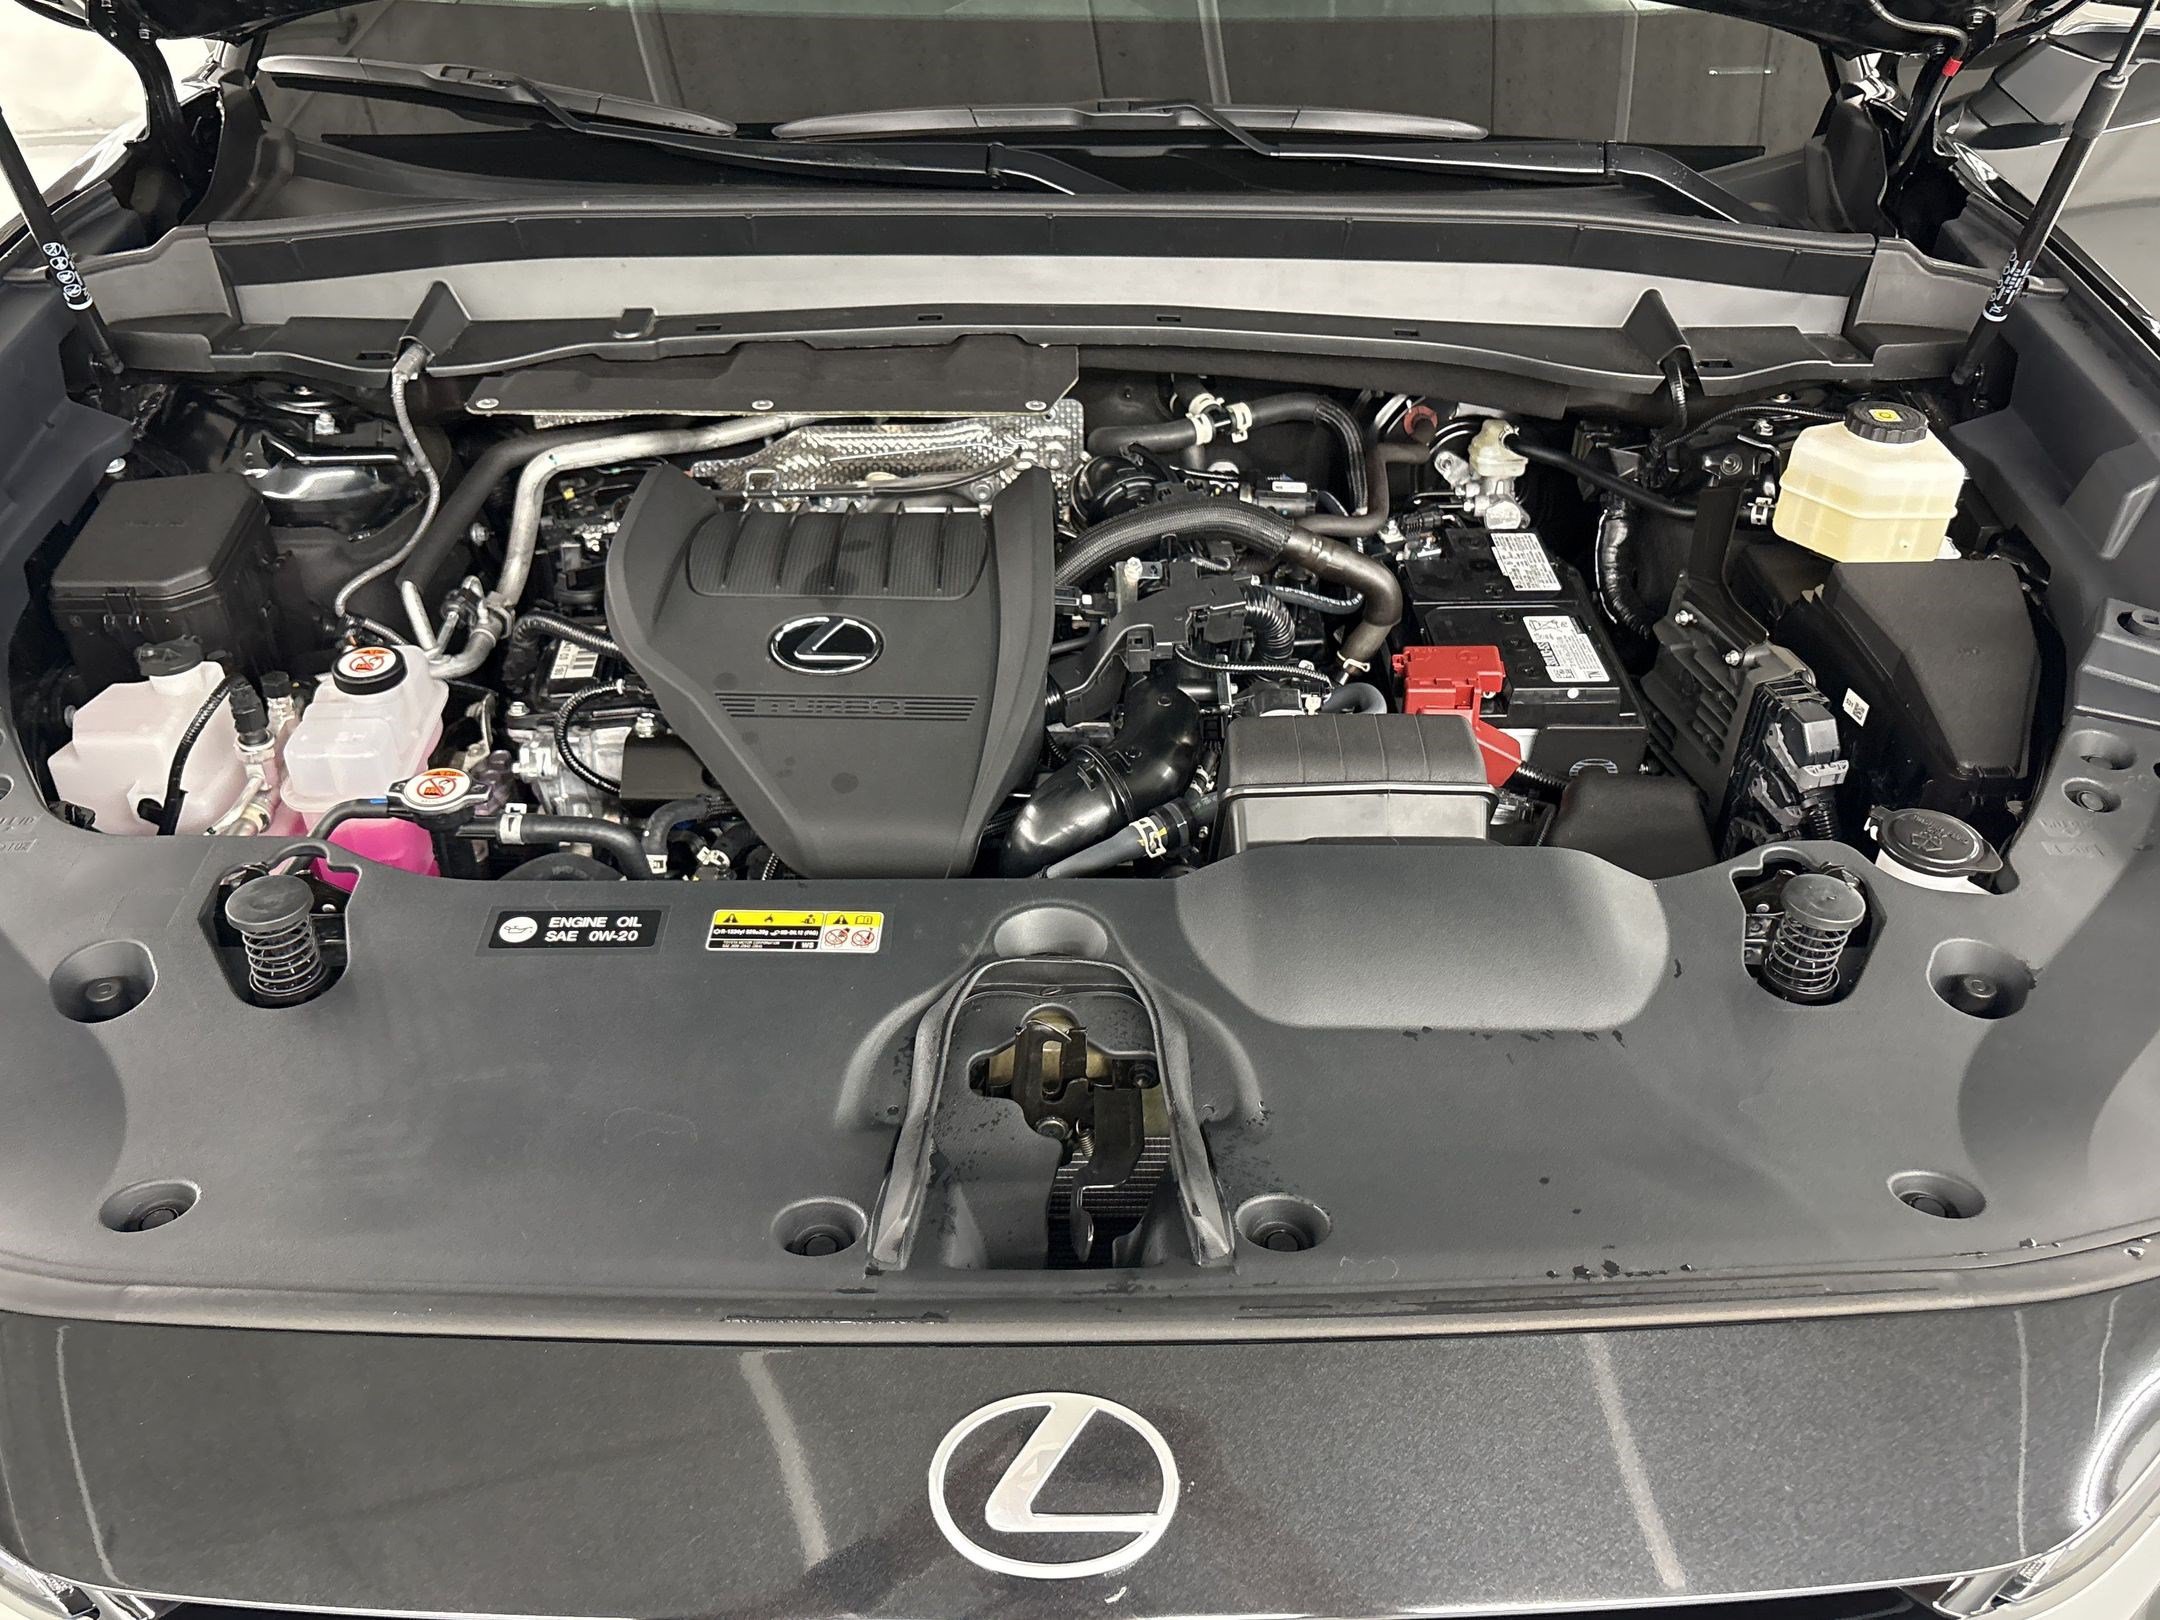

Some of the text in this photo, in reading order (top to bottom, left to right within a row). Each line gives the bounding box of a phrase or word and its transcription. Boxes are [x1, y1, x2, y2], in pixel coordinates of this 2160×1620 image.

[762, 698, 900, 715] TURBO
[548, 916, 643, 928] ENGINE OIL
[544, 930, 639, 942] SAE 0W-20
[801, 941, 815, 949] WS
